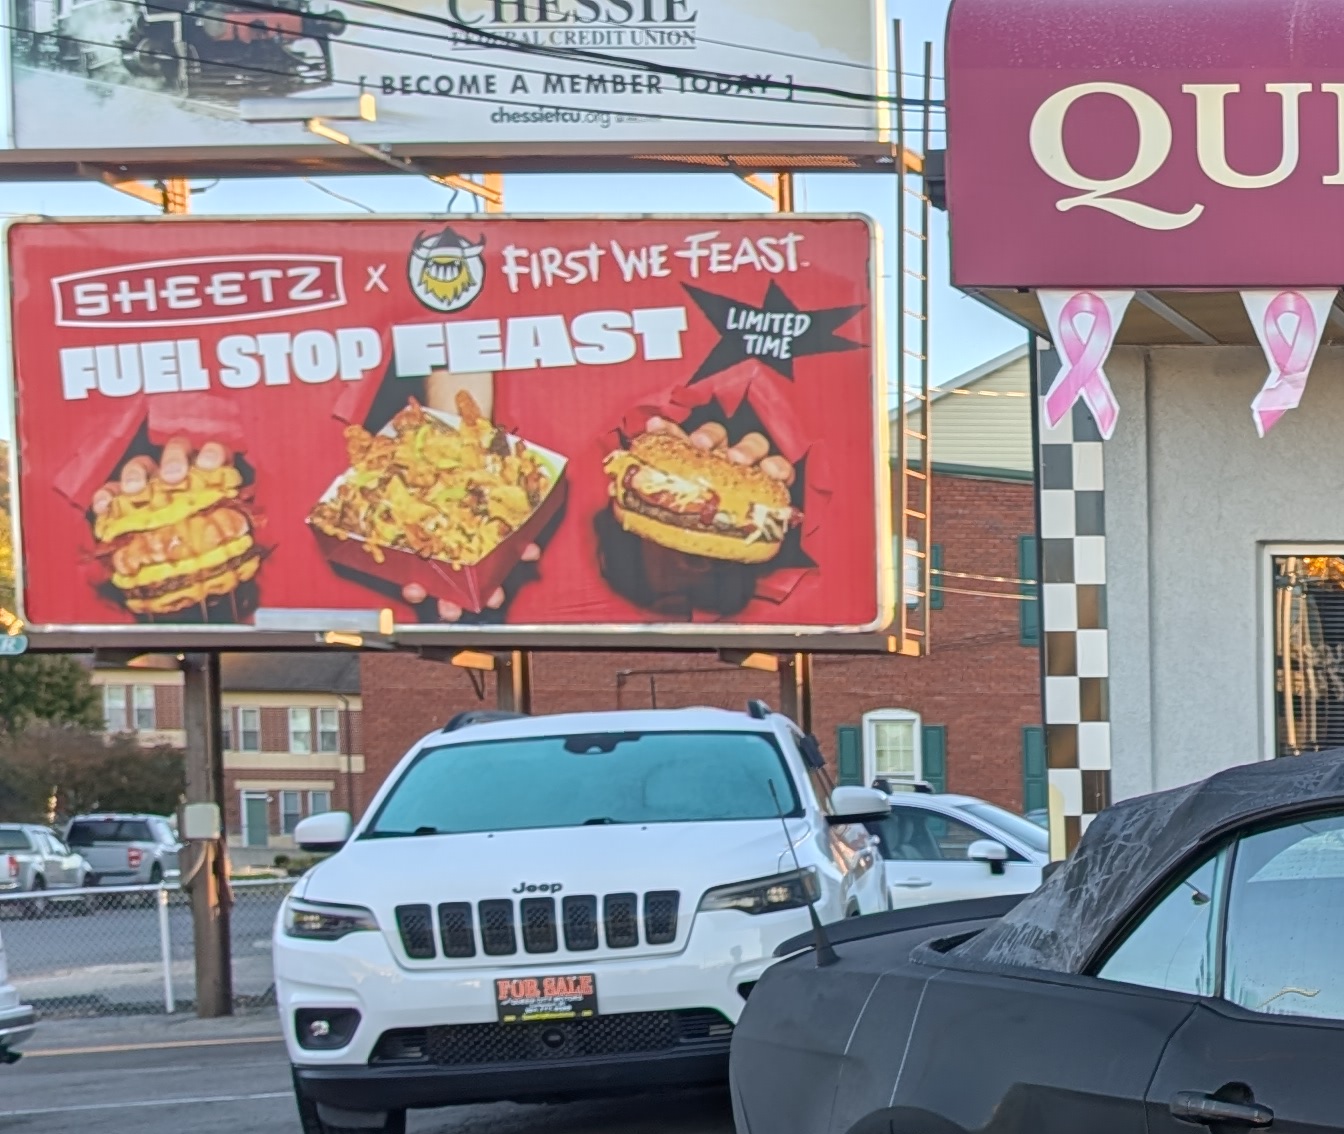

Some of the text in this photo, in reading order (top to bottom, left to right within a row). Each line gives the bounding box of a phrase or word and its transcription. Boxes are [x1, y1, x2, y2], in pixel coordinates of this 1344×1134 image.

[550, 30, 624, 46] CREDIT
[629, 30, 696, 46] UNION
[381, 75, 497, 95] BECOME
[510, 75, 528, 94] A
[543, 75, 662, 95] MEMBER
[490, 106, 612, 129] chessiefcu.org
[73, 266, 323, 317] SHEETZ
[501, 242, 606, 293] FIRST
[610, 240, 671, 283] WE
[675, 231, 805, 278] FEAST
[726, 307, 811, 337] LIMITED
[59, 305, 688, 401] FUEL STOP FEAST
[743, 333, 793, 359] TIME
[512, 881, 563, 894] Jeep
[497, 975, 593, 1000] FOR SALE
